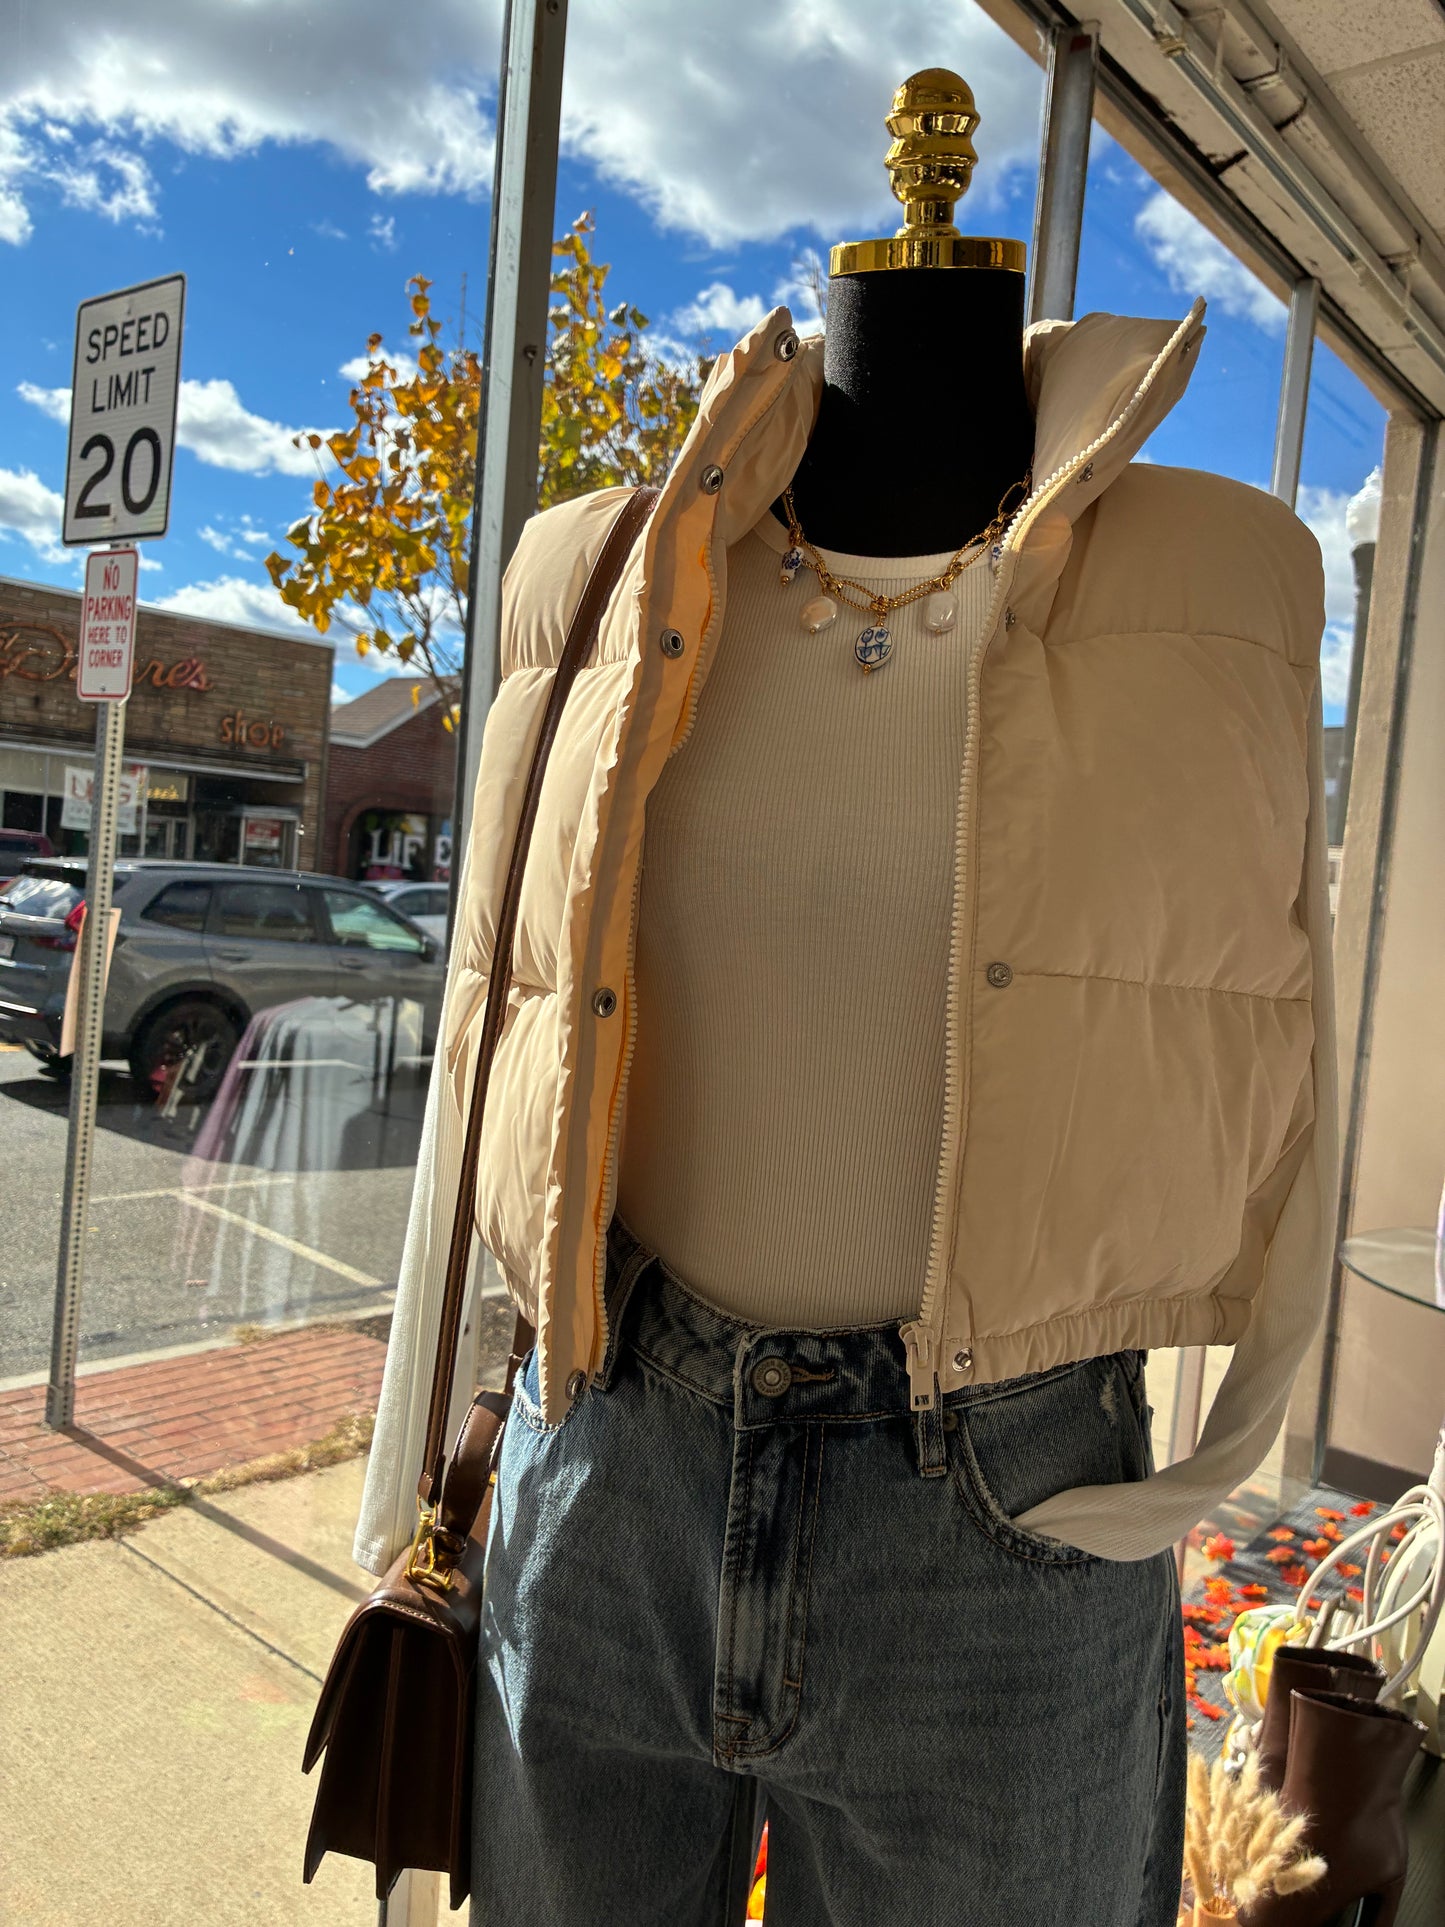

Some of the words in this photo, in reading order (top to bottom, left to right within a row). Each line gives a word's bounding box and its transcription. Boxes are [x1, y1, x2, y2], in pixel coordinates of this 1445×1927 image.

[86, 312, 169, 364] SPEED
[92, 367, 156, 413] LIMIT
[74, 427, 162, 519] 20
[103, 564, 120, 591] NO
[87, 595, 132, 621] PARKING
[87, 626, 111, 644] HERE
[116, 626, 127, 644] TO
[88, 649, 123, 668] CORNER
